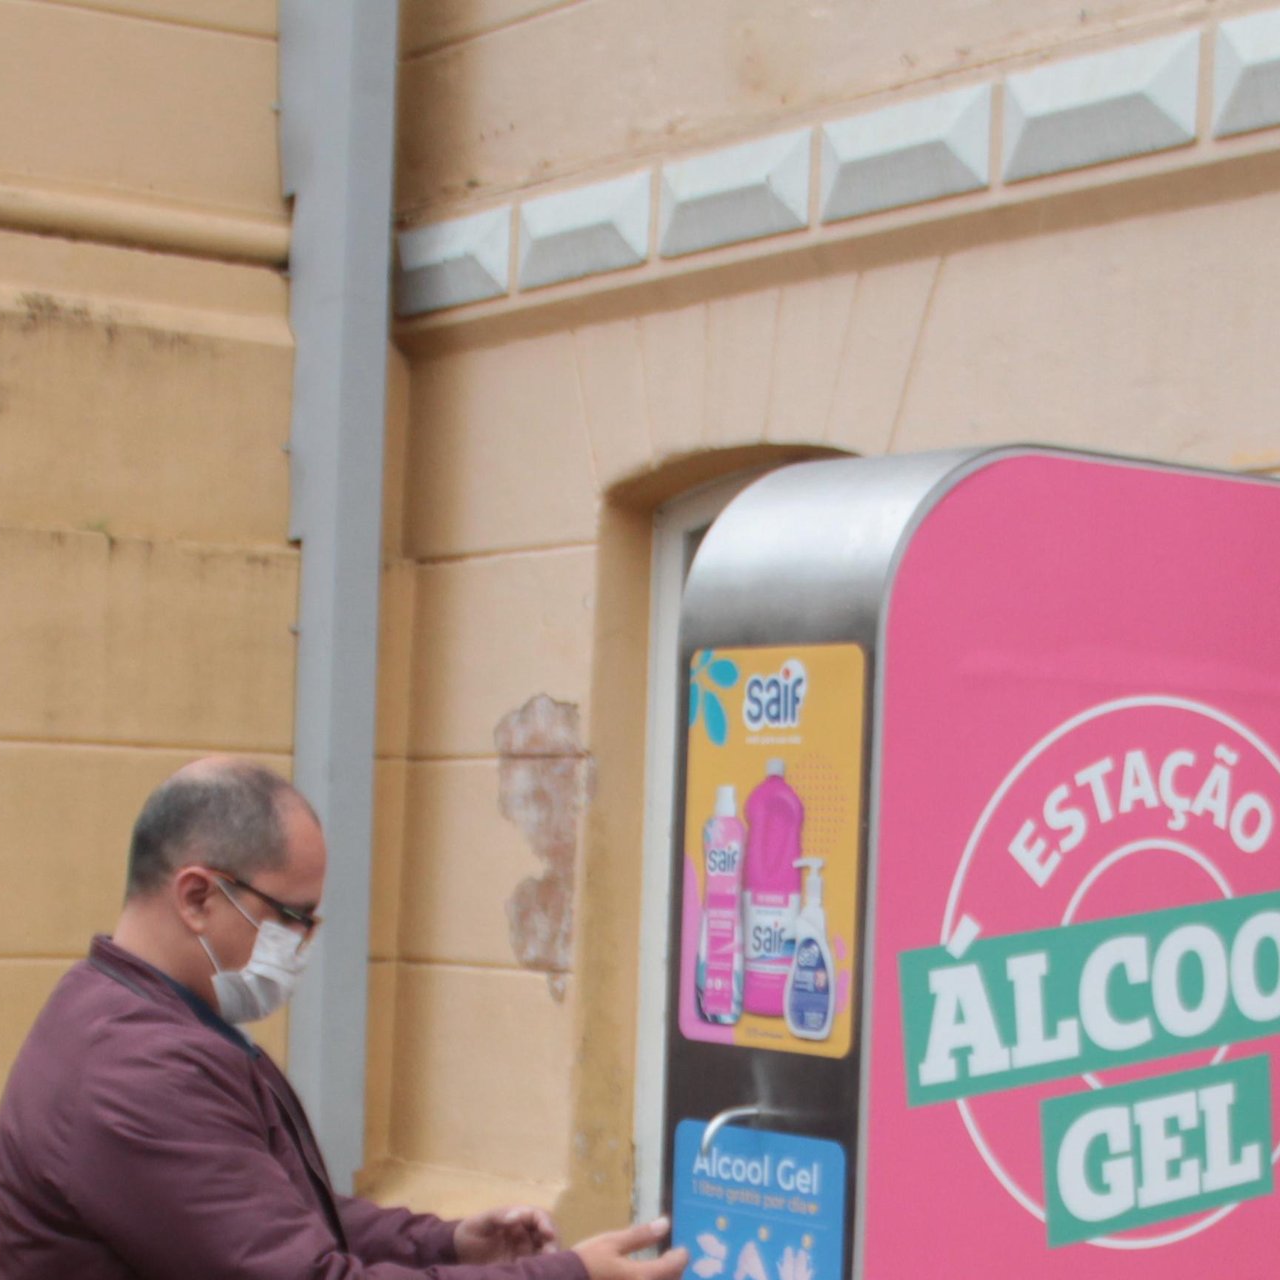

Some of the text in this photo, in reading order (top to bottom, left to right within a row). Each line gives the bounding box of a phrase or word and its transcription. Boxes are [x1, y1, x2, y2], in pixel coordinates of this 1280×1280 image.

[745, 667, 805, 725] saif
[1008, 744, 1275, 887] ESTAÇÃO
[776, 1158, 820, 1195] Gel
[1056, 1082, 1261, 1224] GEL
